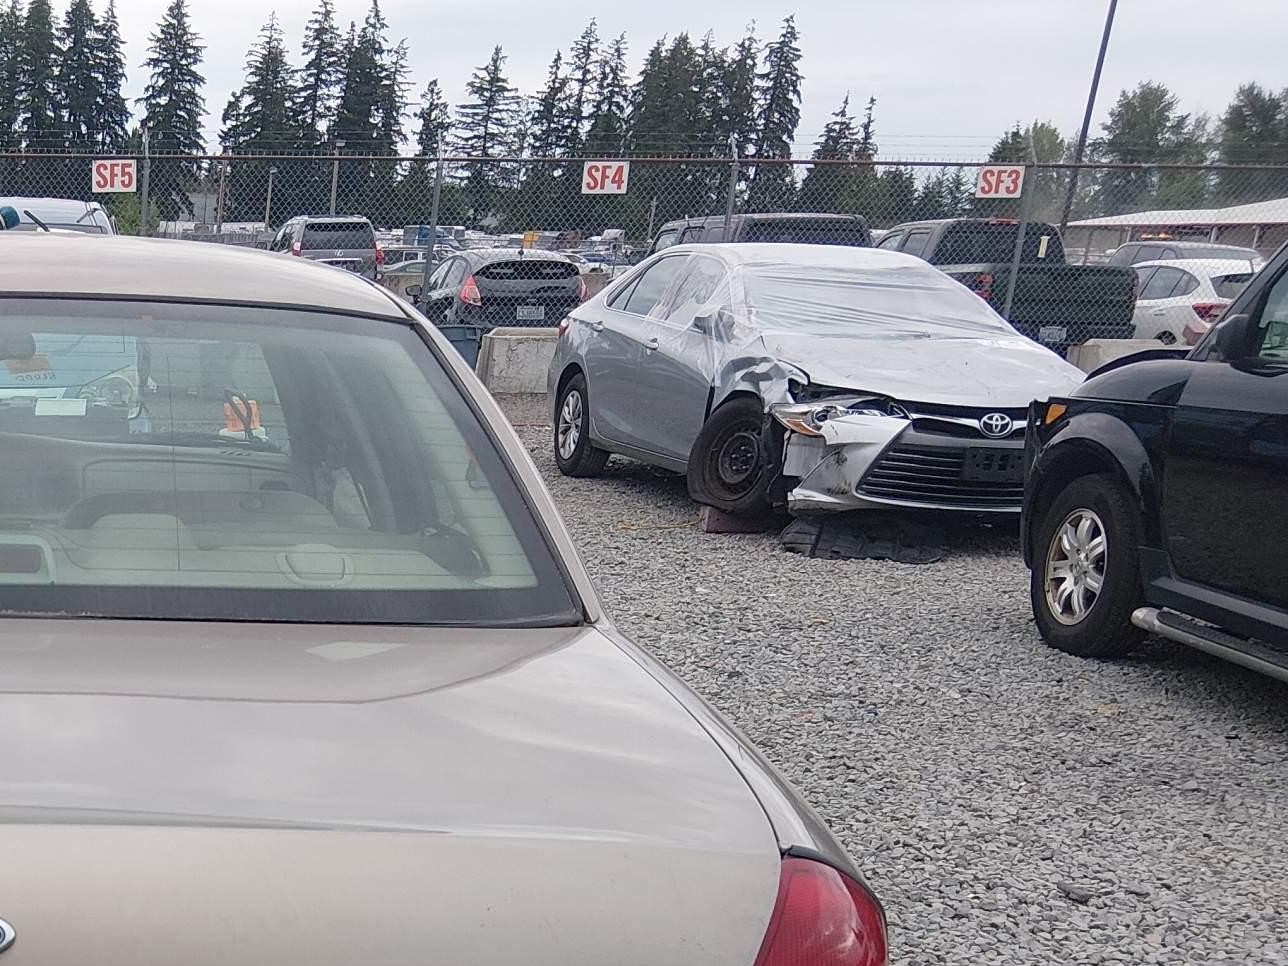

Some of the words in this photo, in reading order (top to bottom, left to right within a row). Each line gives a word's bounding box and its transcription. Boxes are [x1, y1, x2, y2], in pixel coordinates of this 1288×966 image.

[95, 162, 134, 189] SF5
[586, 164, 625, 191] SF4
[980, 169, 1021, 195] SF3
